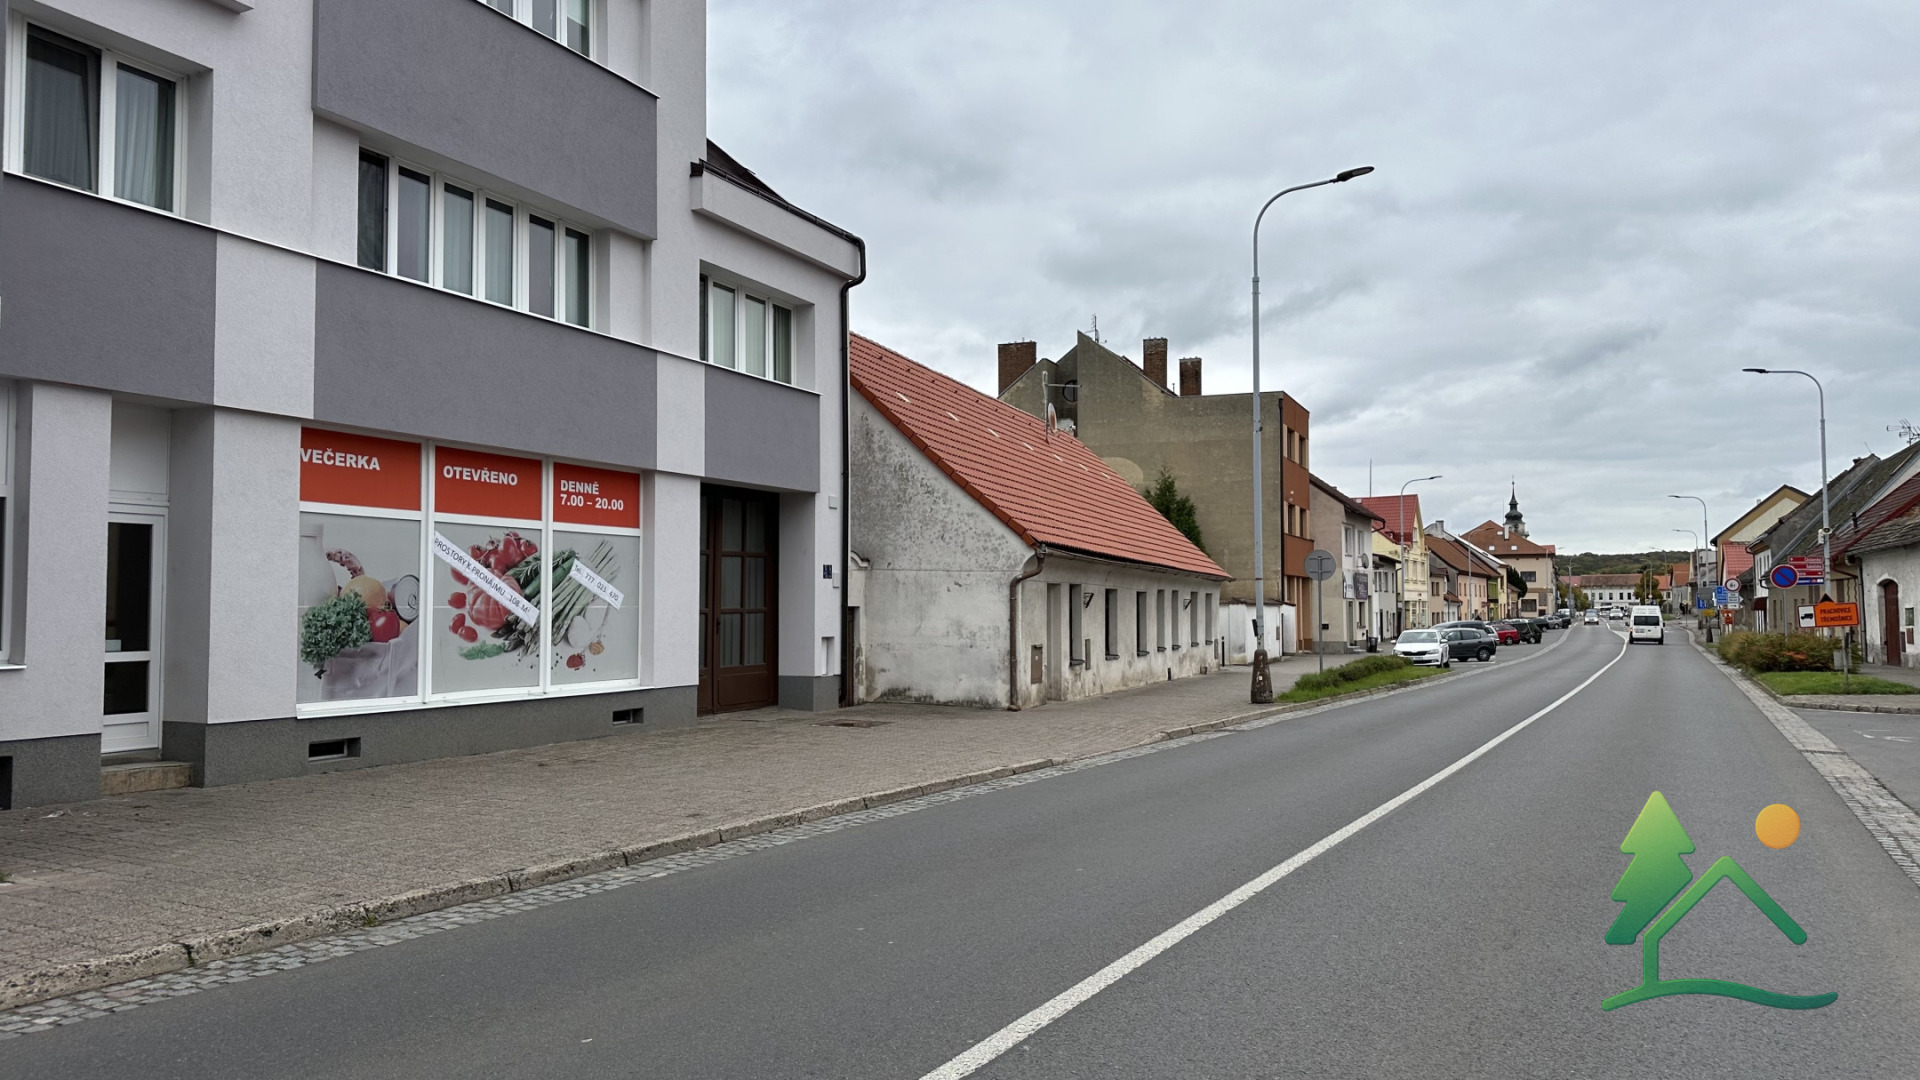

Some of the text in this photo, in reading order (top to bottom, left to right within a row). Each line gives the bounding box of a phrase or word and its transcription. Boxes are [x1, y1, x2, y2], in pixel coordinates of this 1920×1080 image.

[300, 448, 380, 470] VEČERKA
[443, 465, 518, 486] OTEVŘENO
[560, 480, 599, 495] DENNĚ
[560, 494, 584, 507] 7.00
[595, 498, 624, 510] 20.00
[434, 538, 467, 566] PROSTORY
[584, 572, 595, 583] 777
